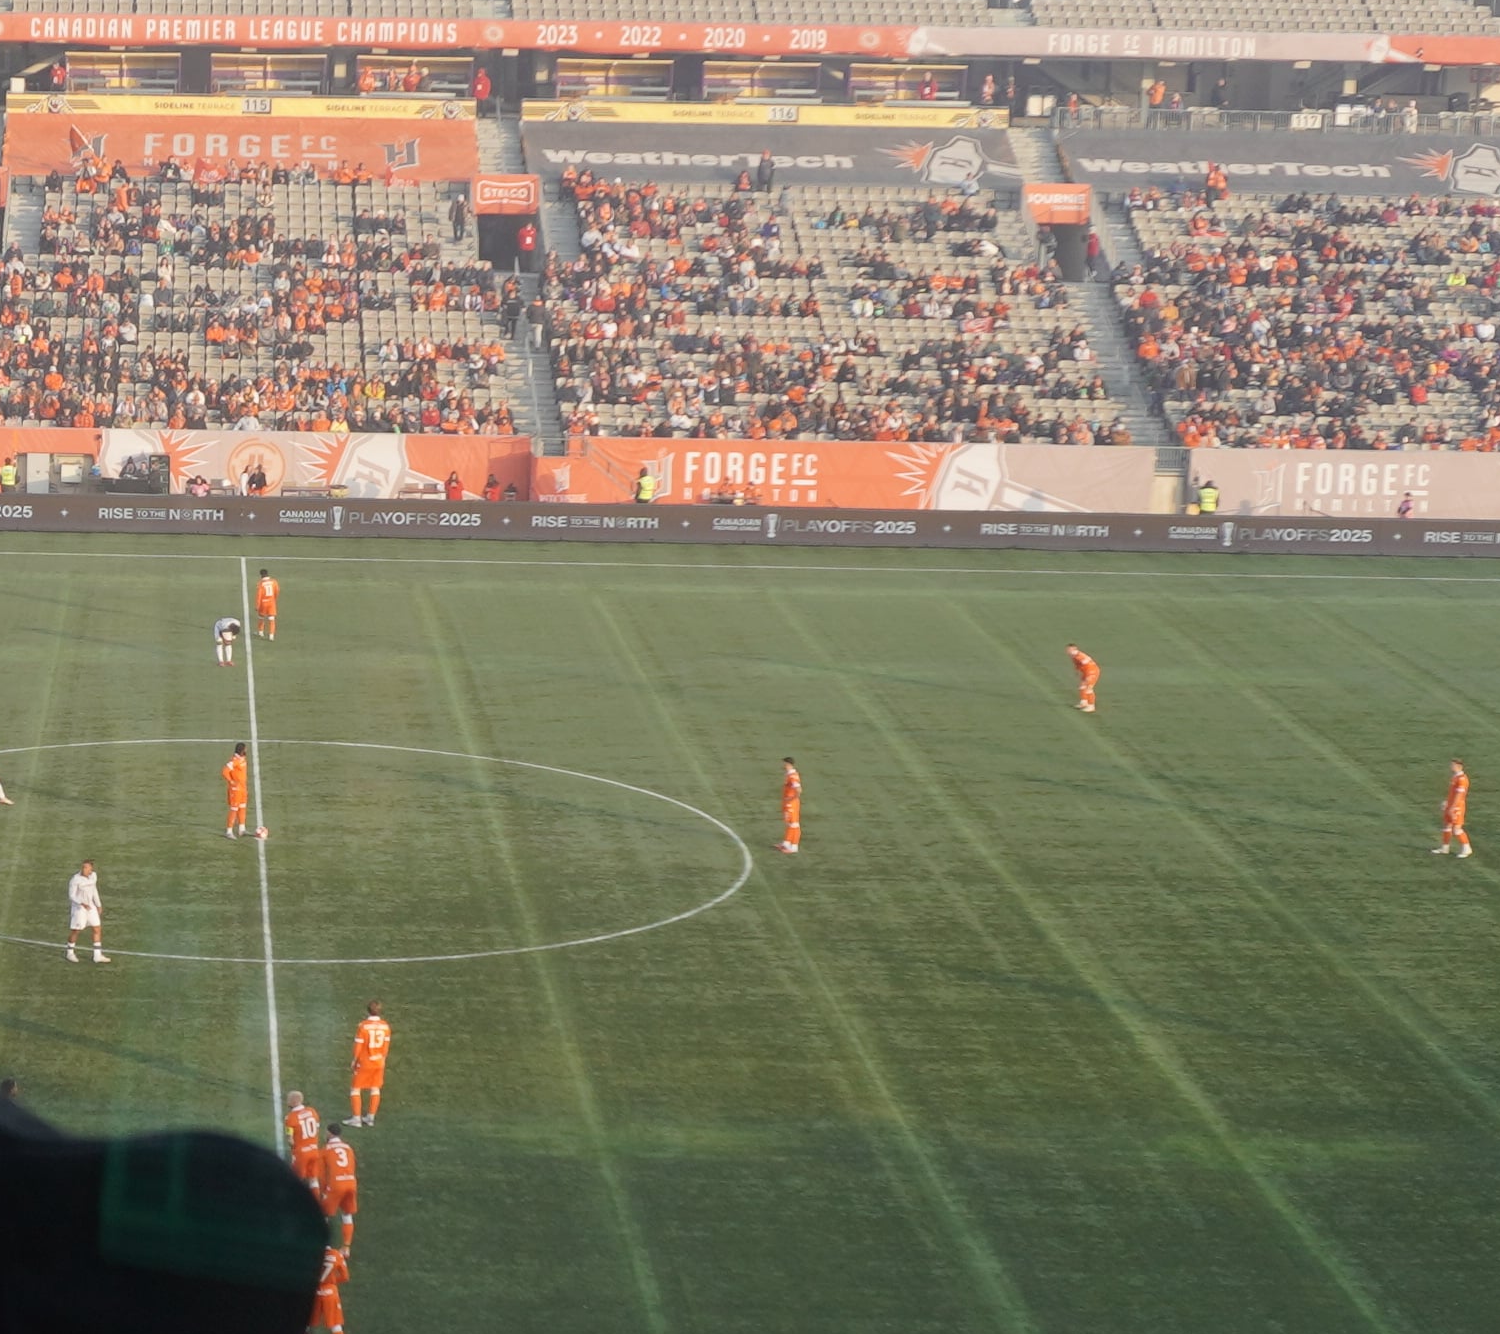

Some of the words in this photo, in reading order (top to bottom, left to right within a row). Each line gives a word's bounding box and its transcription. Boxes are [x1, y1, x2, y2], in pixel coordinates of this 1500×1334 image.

[30, 17, 133, 39] CANADIAN
[145, 18, 236, 40] PREMIER
[249, 19, 325, 41] LEAGUE
[336, 20, 458, 43] CHAMPIONS
[537, 25, 578, 46] 2023
[620, 26, 661, 47] 2022
[704, 27, 746, 48] 2020
[790, 28, 827, 49] 2019
[1047, 33, 1111, 54] FORGE
[1152, 35, 1257, 57] HAMILTON
[244, 97, 267, 111] 115
[771, 107, 794, 120] 116
[1295, 115, 1317, 127] 117
[144, 133, 291, 157] FORGE
[302, 135, 337, 151] FC
[543, 149, 859, 168] WeatherTech
[483, 187, 529, 198] STELCO
[683, 451, 787, 486] FORGE
[791, 453, 818, 477] FC
[1295, 462, 1400, 496] FORGE
[1404, 463, 1430, 487] FC
[98, 508, 134, 520] RISE
[368, 1029, 384, 1049] 13
[301, 1117, 318, 1140] 10
[336, 1147, 349, 1168] 3
